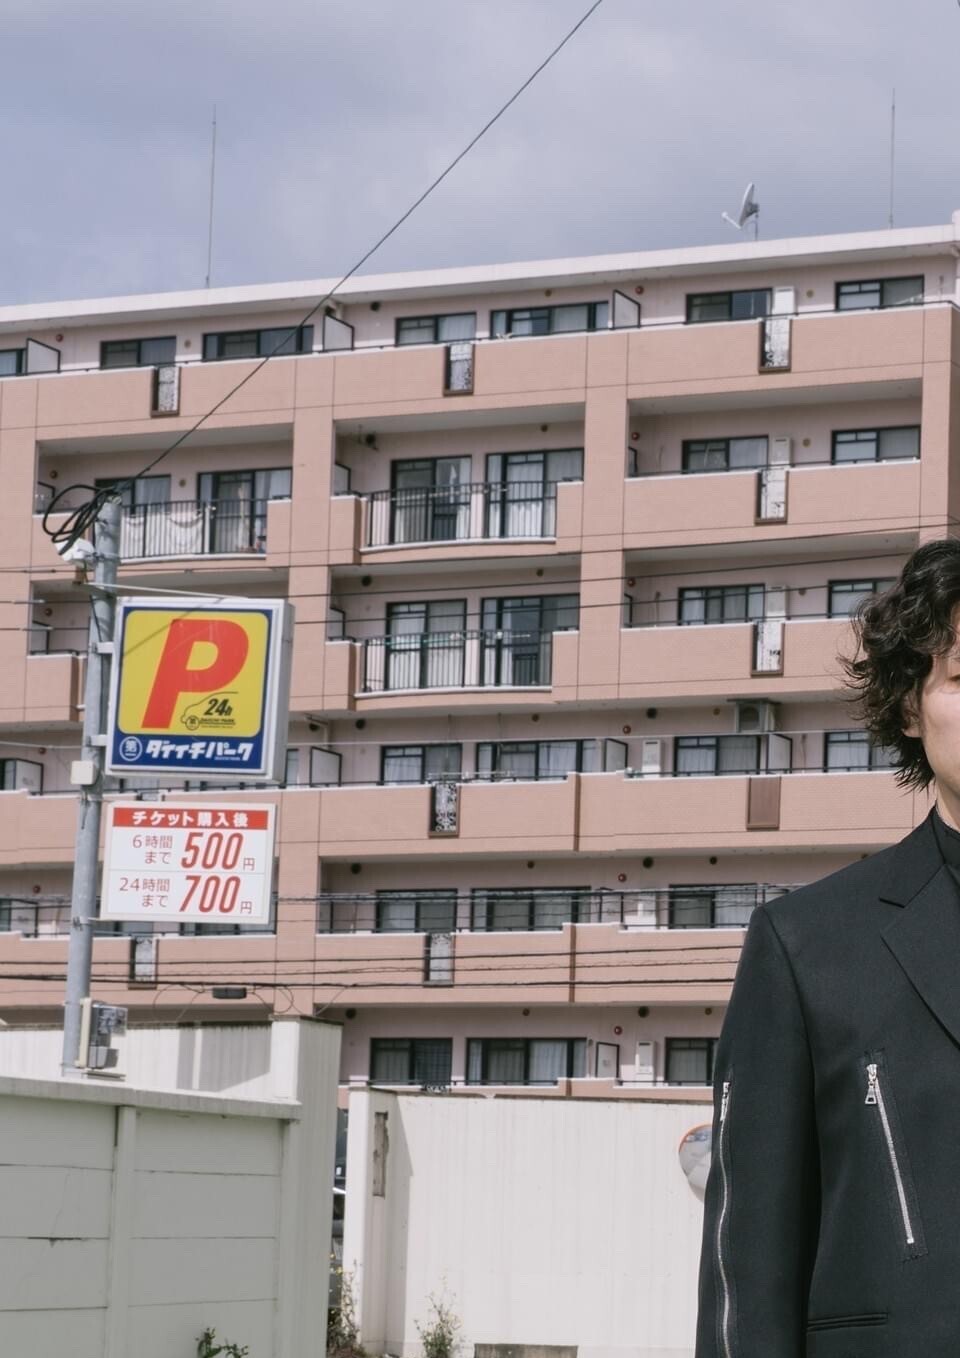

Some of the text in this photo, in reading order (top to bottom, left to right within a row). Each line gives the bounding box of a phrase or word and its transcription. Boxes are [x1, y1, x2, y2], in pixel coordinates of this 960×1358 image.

[141, 619, 249, 729] P
[132, 811, 248, 828] チケット購入後
[132, 834, 173, 849] 6時間
[144, 851, 172, 865] まで
[119, 877, 170, 893] 24時間
[142, 895, 169, 908] まで
